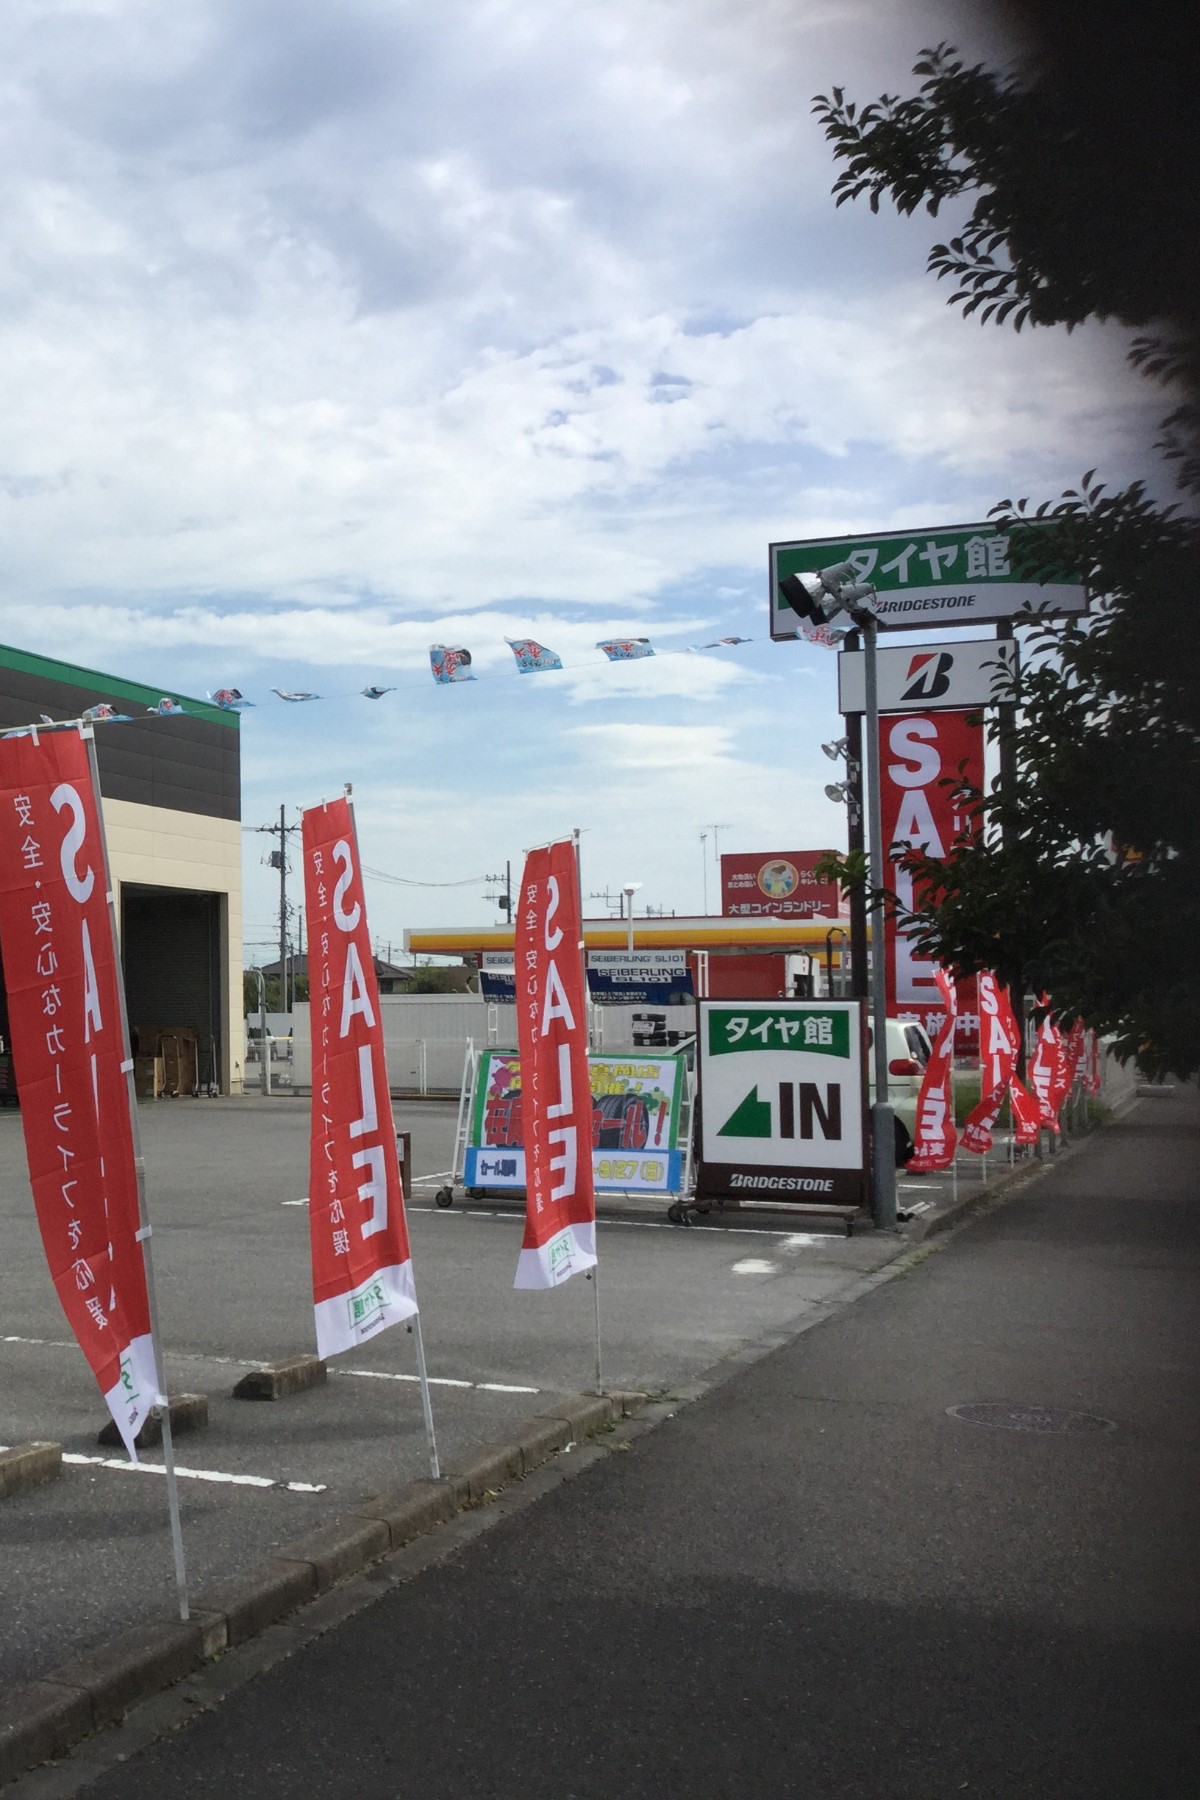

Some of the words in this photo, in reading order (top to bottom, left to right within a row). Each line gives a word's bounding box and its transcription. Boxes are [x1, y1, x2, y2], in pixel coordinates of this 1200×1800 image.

[848, 534, 1011, 585] タイヤ館
[875, 595, 976, 614] BRIDGESTONE
[887, 718, 947, 1004] SALE
[728, 900, 831, 915] 大型コインランドリー
[591, 955, 651, 963] SEIBERLING
[655, 955, 684, 963] SL101
[598, 968, 685, 977] SEIBERLING
[725, 1016, 833, 1045] タイヤ館
[779, 1082, 842, 1141] IN
[729, 1173, 835, 1192] BRIDGESTONE
